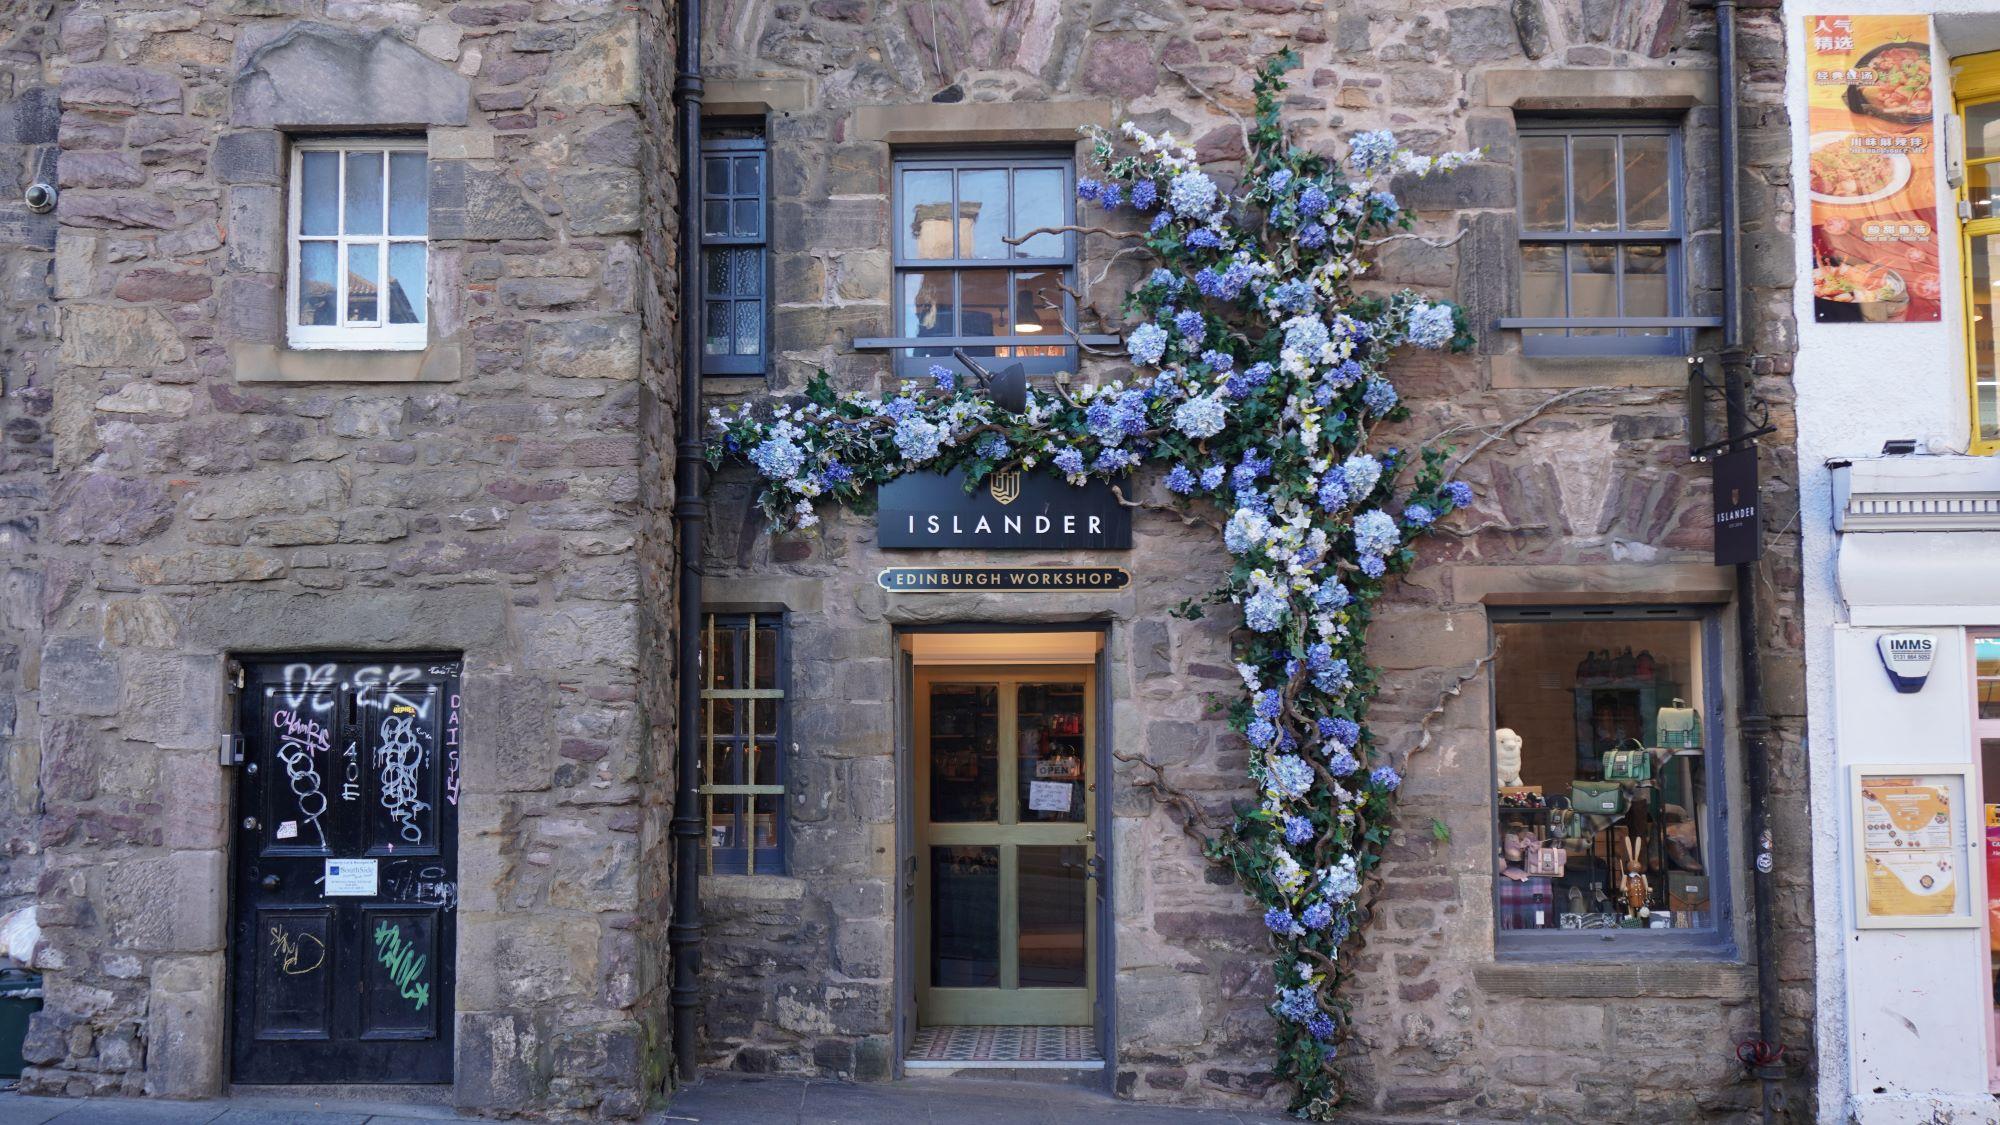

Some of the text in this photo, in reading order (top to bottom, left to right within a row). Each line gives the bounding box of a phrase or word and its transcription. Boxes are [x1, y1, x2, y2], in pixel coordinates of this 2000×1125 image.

[1814, 19, 1854, 34] 人气
[1814, 36, 1855, 51] 精选
[1717, 507, 1755, 523] ISLANDER
[908, 515, 1102, 534] ISLANDER
[896, 573, 1113, 585] EDINBURGH WORKSHOP
[1890, 639, 1932, 650] IMMS
[446, 694, 460, 806] DAISY
[1039, 766, 1069, 775] OPEN
